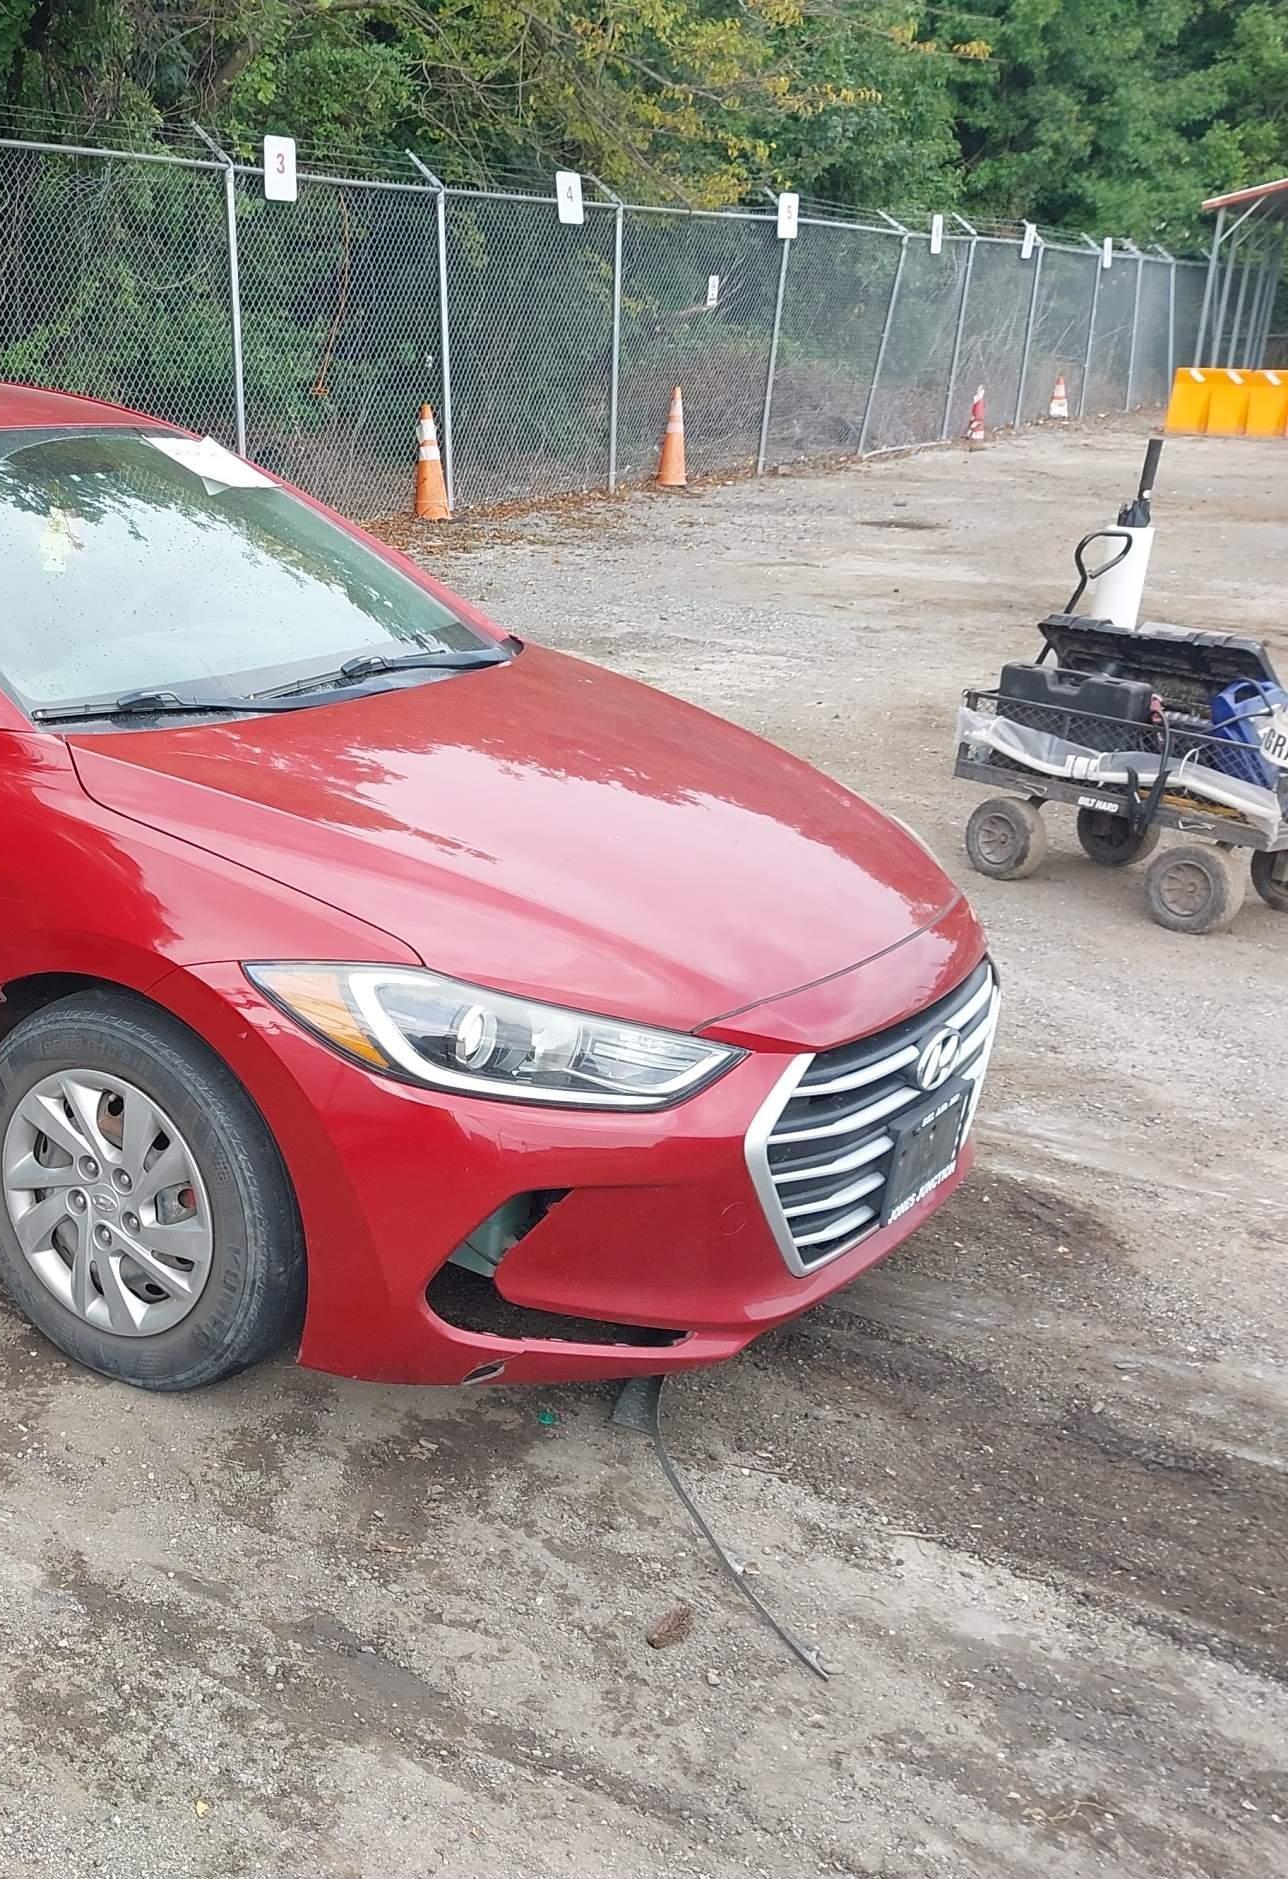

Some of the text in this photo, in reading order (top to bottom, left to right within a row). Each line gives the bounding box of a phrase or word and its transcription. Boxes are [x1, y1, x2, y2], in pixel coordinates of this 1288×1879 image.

[276, 152, 286, 174] 3
[566, 185, 574, 202] 4
[786, 204, 794, 220] 5
[887, 1159, 957, 1226] JONES JUNCTION
